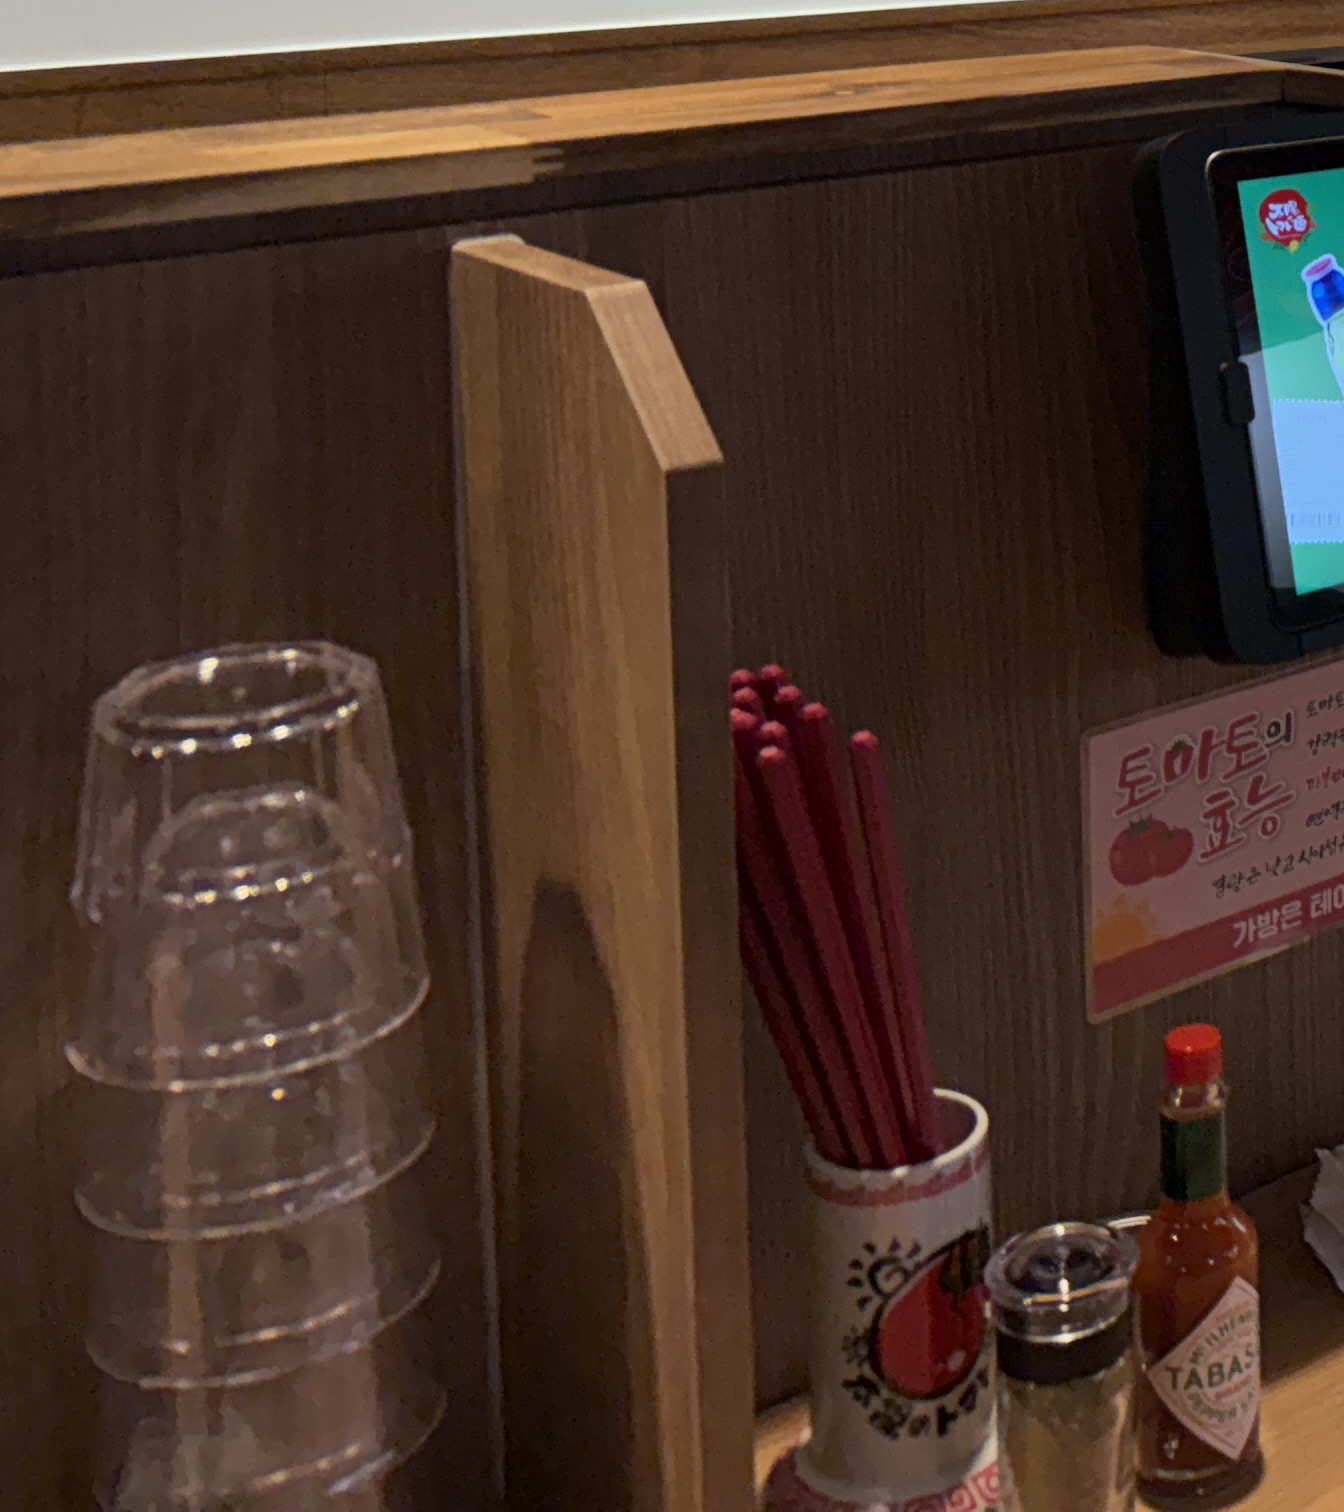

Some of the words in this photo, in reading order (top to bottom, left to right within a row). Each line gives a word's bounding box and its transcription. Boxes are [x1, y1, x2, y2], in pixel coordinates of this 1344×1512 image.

[1114, 710, 1294, 816] 토마토의
[1199, 774, 1295, 859] 효능
[1232, 901, 1303, 949] 가방은
